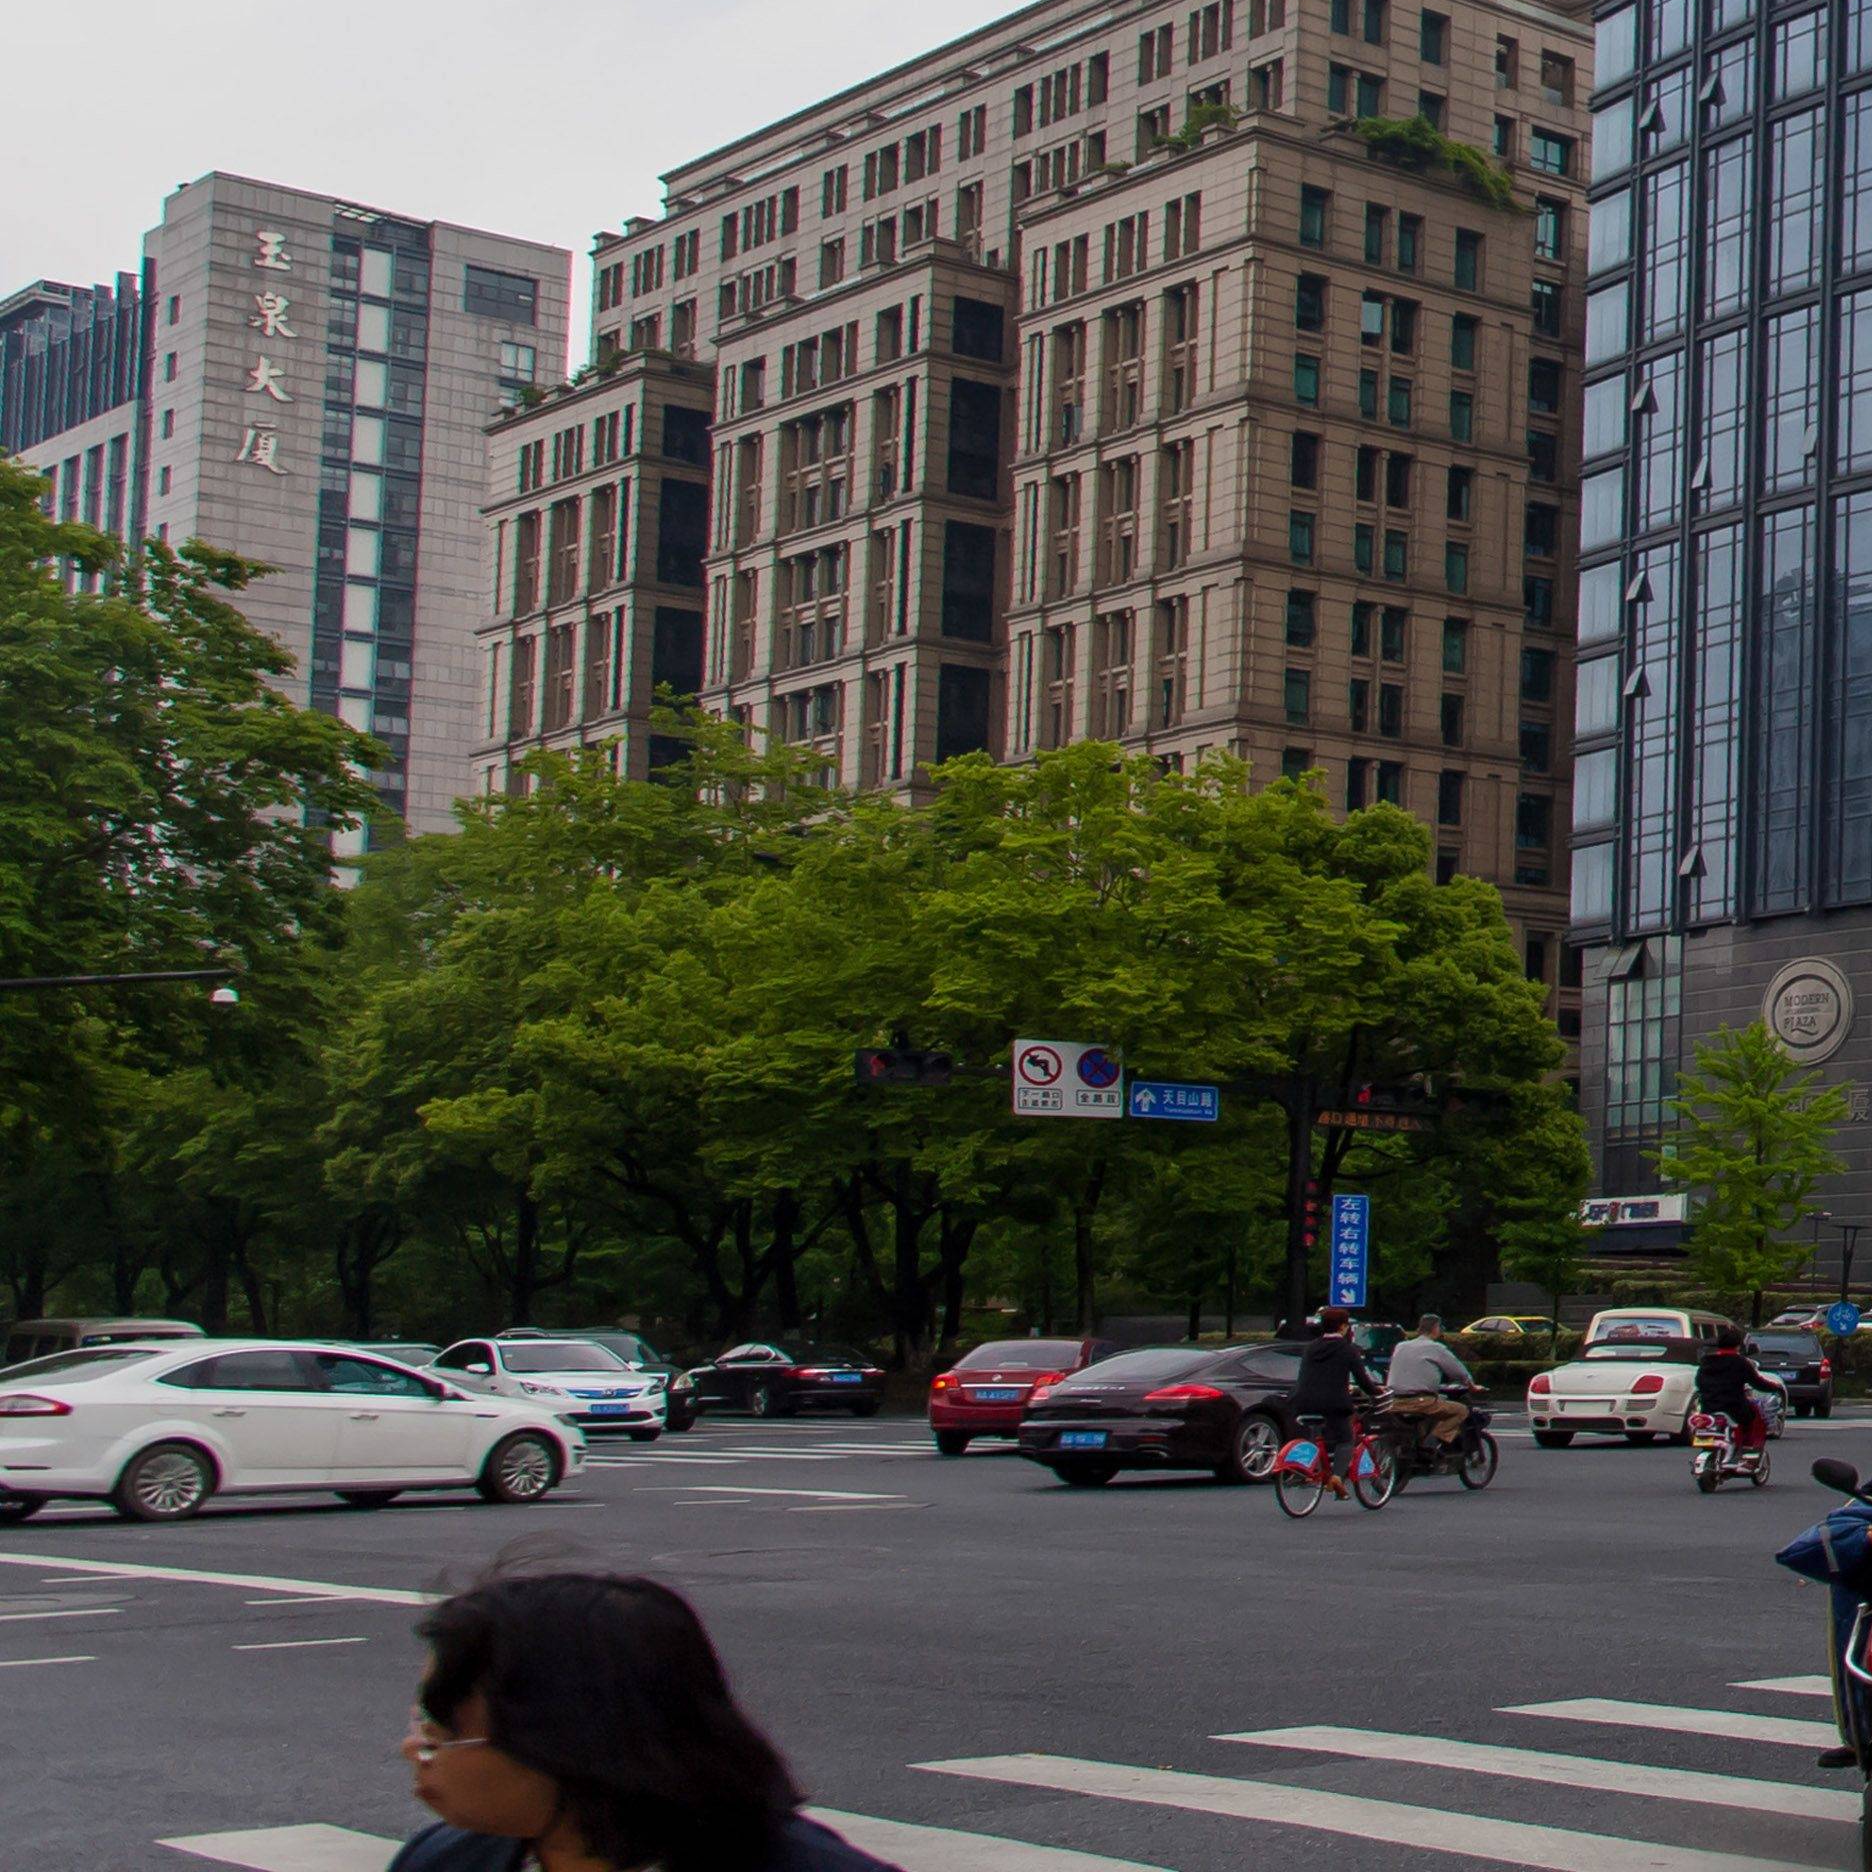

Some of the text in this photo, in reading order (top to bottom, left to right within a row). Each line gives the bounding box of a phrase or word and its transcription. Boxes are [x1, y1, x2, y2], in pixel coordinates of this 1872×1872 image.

[235, 231, 299, 475] 玉泉大厦
[1162, 1089, 1212, 1108] 天目山路
[1337, 1198, 1362, 1285] 左转右转车辆
